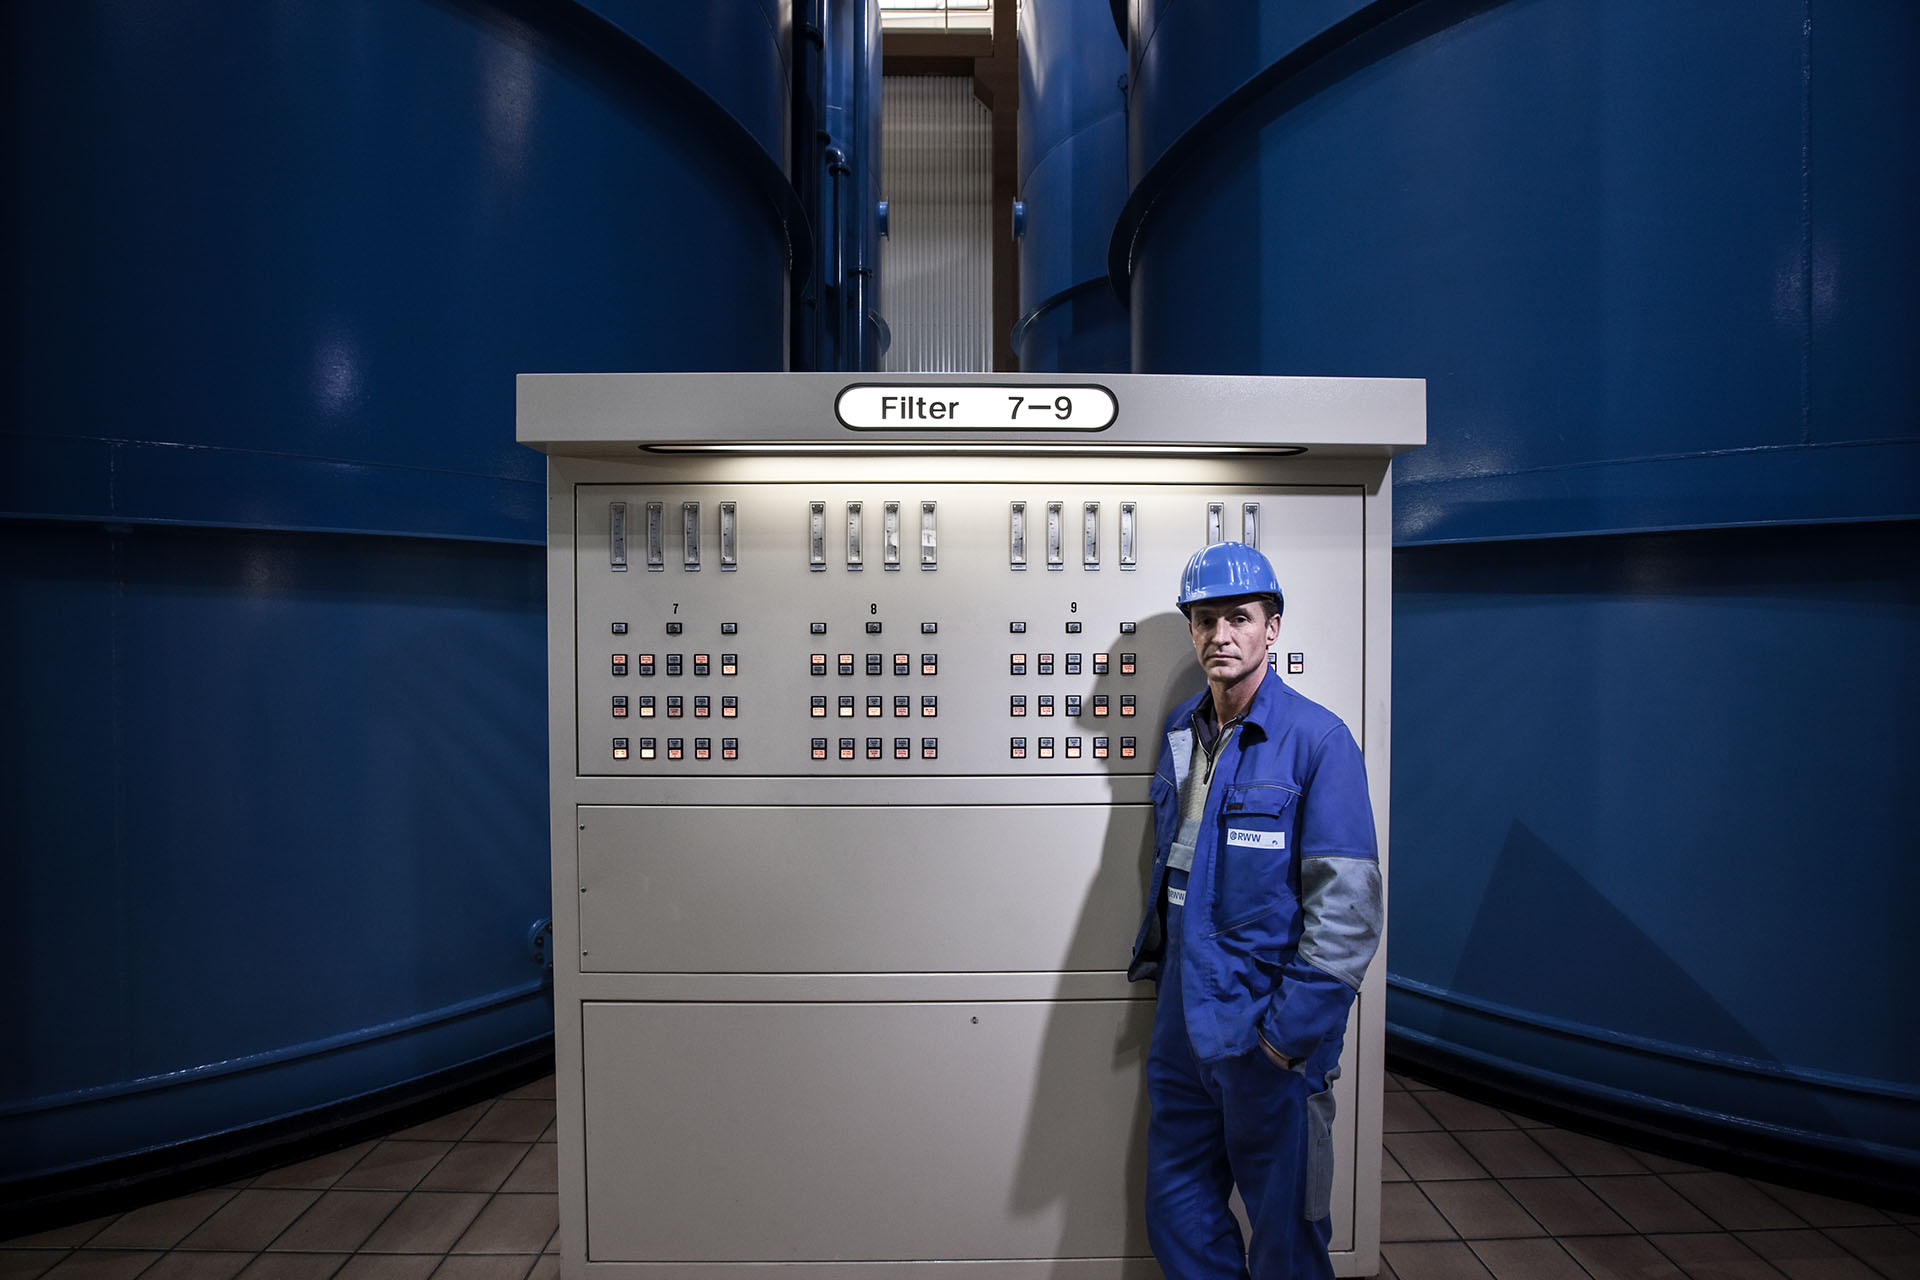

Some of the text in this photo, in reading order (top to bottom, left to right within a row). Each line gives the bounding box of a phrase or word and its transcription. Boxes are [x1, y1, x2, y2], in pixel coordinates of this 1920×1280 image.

[881, 396, 960, 420] Filter
[672, 603, 679, 615] 7
[870, 603, 877, 615] 8
[1070, 601, 1077, 614] 9
[1237, 832, 1262, 843] RWW
